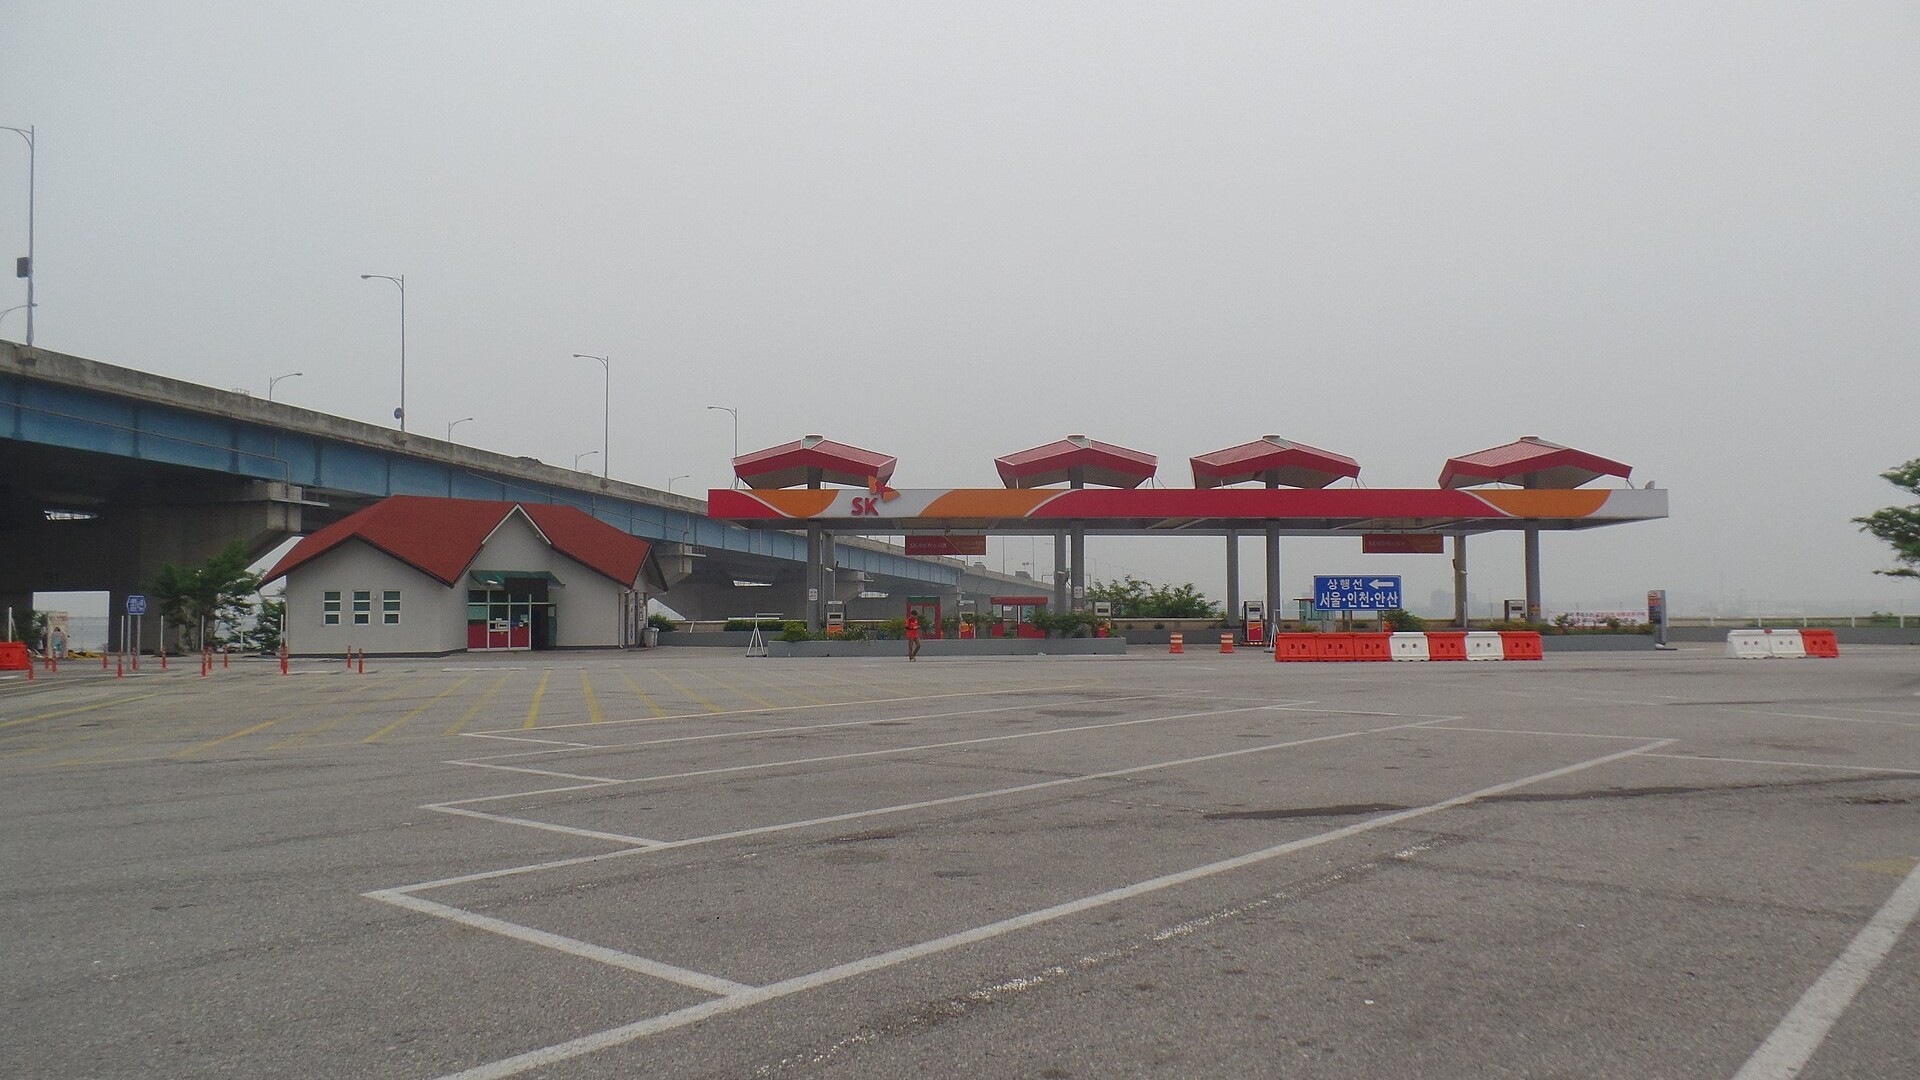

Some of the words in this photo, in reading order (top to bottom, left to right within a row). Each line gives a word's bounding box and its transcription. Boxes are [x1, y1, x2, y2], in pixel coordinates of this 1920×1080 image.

[851, 496, 879, 516] SK
[1327, 579, 1363, 590] 상행선
[1320, 591, 1398, 608] 서울·인천·안산
